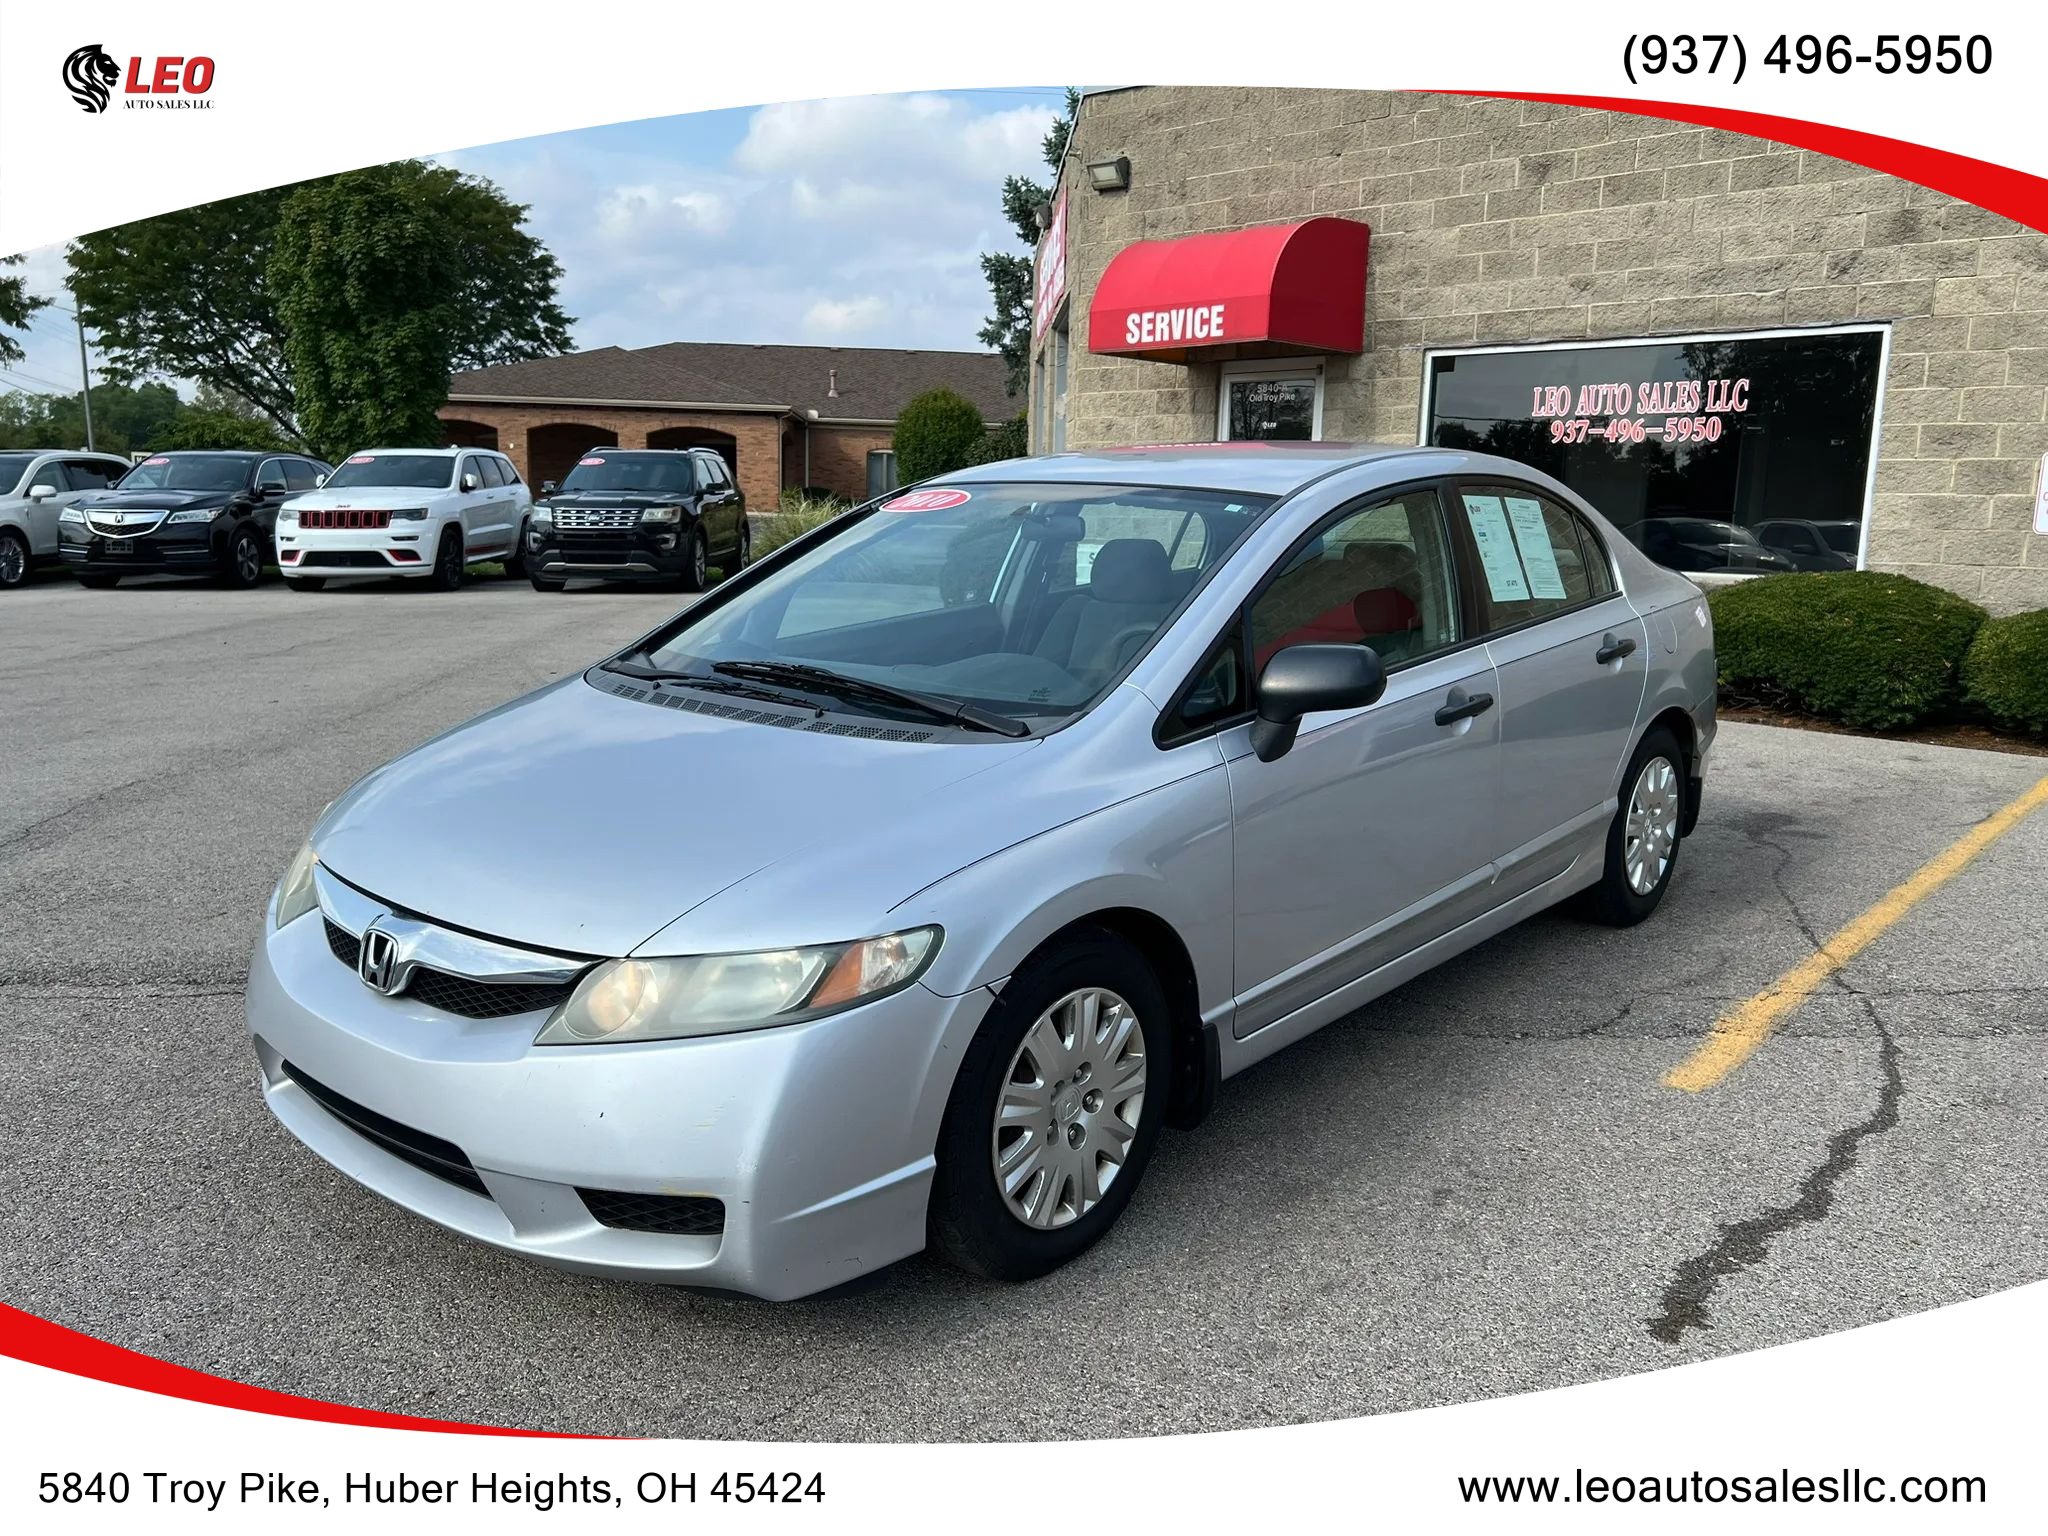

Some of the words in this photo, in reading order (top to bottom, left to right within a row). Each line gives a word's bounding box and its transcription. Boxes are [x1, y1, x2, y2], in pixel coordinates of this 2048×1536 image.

[1126, 305, 1225, 344] SERVICE
[1249, 393, 1263, 402] Old
[1263, 393, 1279, 403] Troy
[1279, 392, 1296, 401] Pike
[1256, 383, 1288, 393] 5840-A
[1532, 385, 1572, 417] LEO
[1575, 383, 1633, 416] AUTO
[1637, 380, 1701, 414] SALES
[1705, 379, 1750, 413] LLC
[1550, 416, 1722, 444] 937-496-5950
